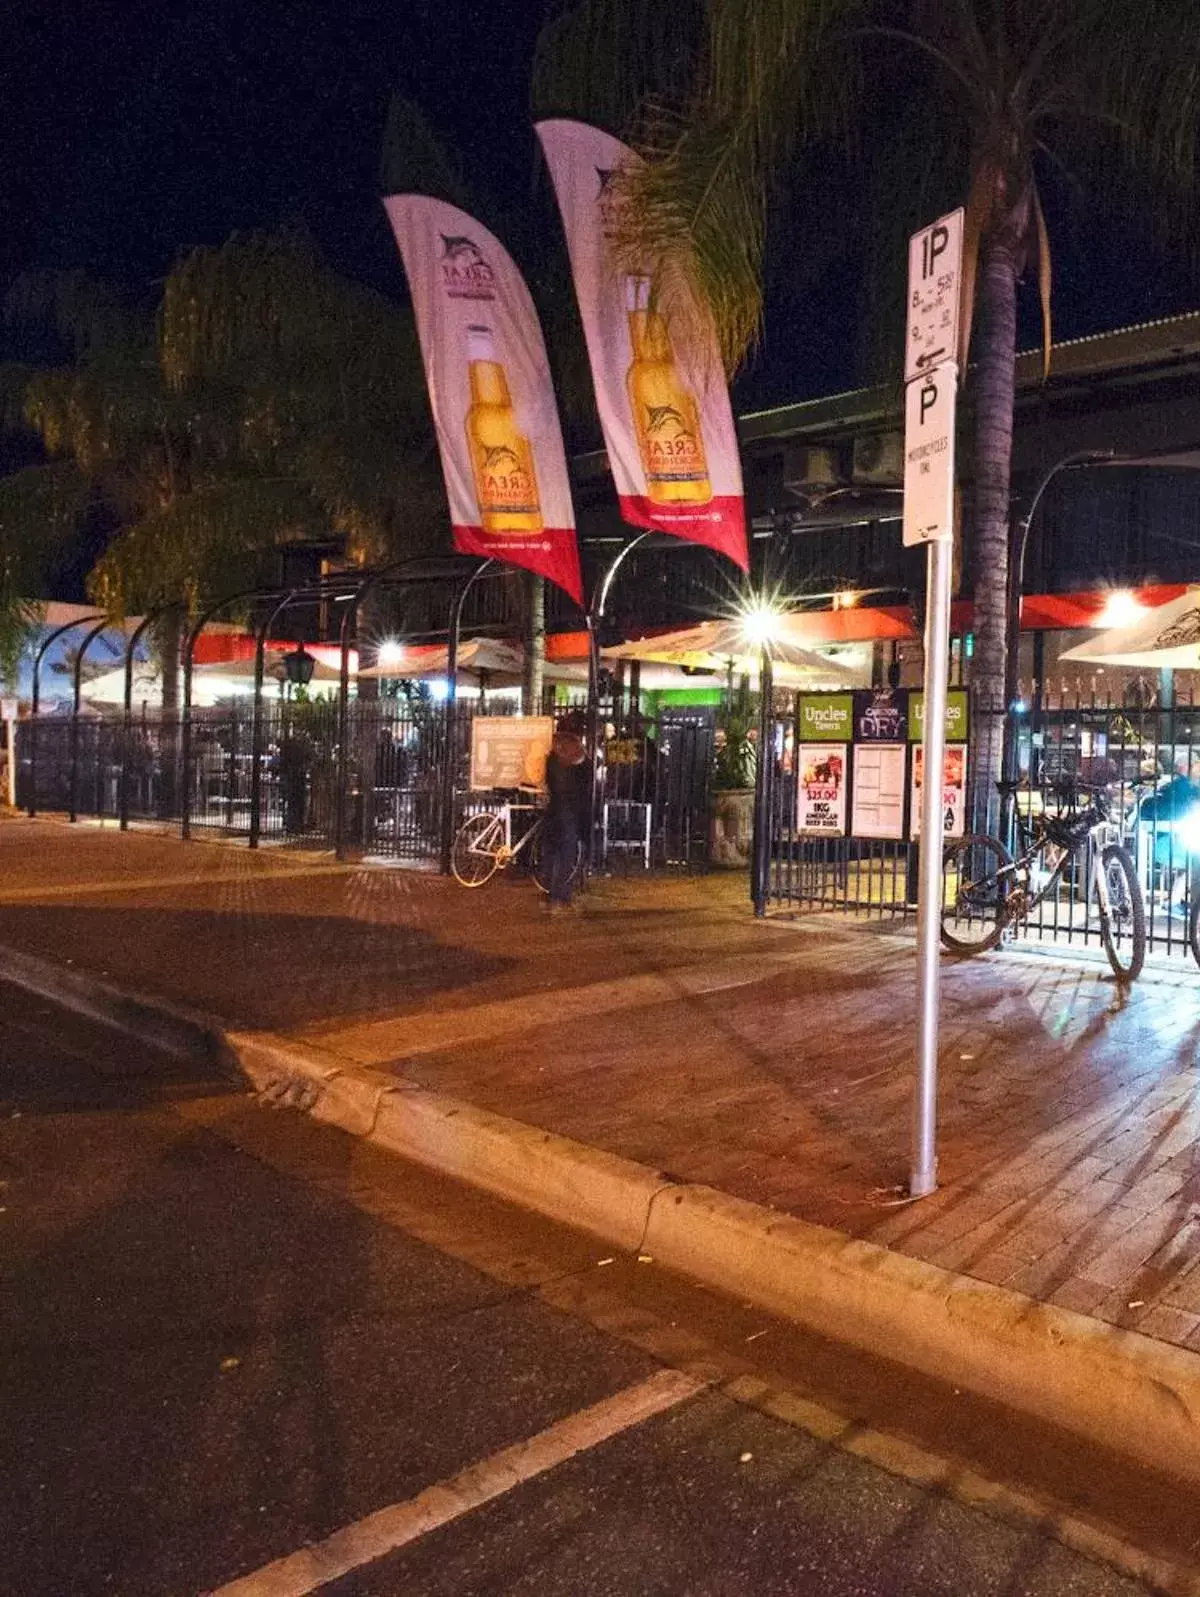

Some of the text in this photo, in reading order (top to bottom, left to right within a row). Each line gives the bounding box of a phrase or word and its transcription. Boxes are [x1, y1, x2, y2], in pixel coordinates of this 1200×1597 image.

[921, 224, 950, 281] 1P
[919, 384, 938, 425] P
[805, 704, 848, 721] Uncles
[859, 715, 907, 737] DRY
